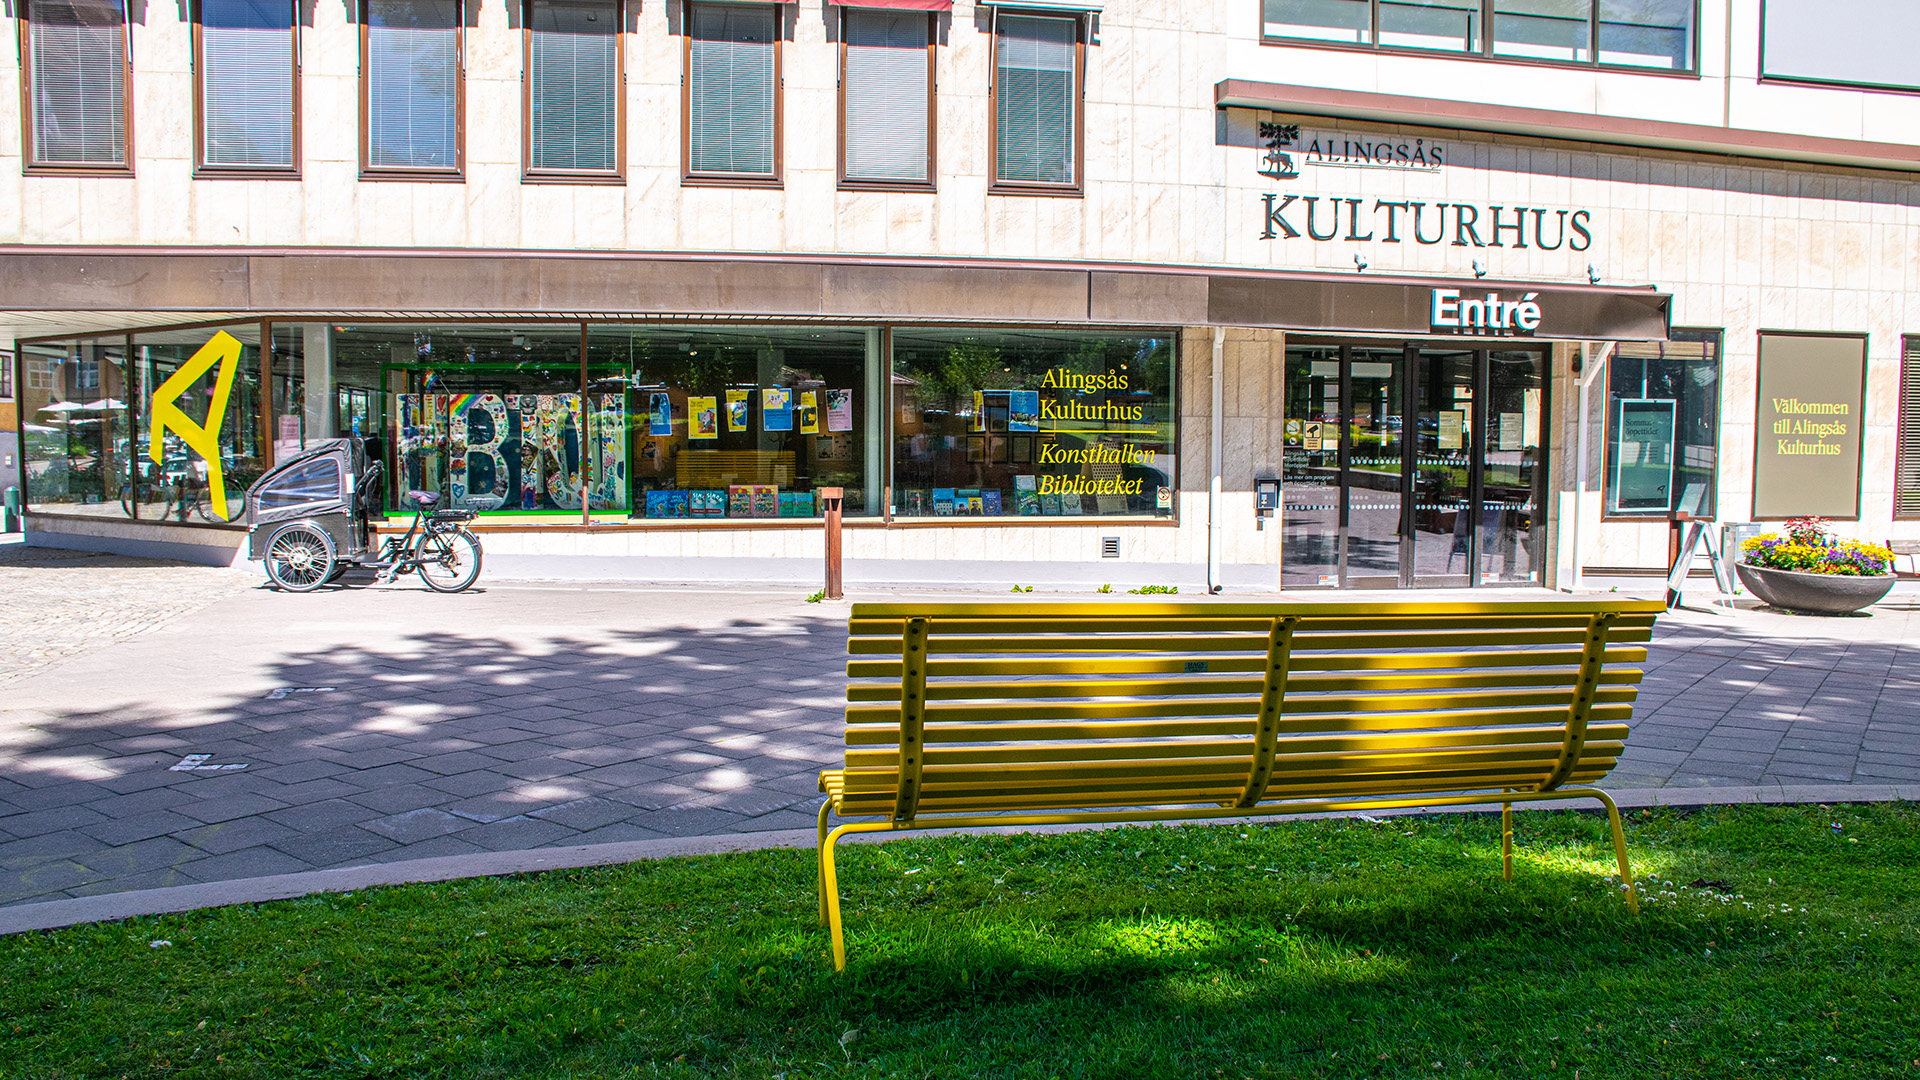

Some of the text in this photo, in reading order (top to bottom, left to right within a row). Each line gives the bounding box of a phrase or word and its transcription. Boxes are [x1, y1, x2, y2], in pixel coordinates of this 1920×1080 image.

[1305, 138, 1443, 168] ALINGSÅS
[1259, 193, 1592, 252] KULTURHUS
[1431, 289, 1542, 331] Entré
[1040, 368, 1129, 393] Alingsås
[1039, 399, 1143, 421] Kulturhus
[1772, 398, 1849, 415] Välkommen
[1773, 419, 1847, 438] till Alingsås
[1038, 443, 1155, 464] Konsthallen
[1777, 439, 1841, 456] Kulturhus
[1038, 474, 1143, 496] Biblioteket
